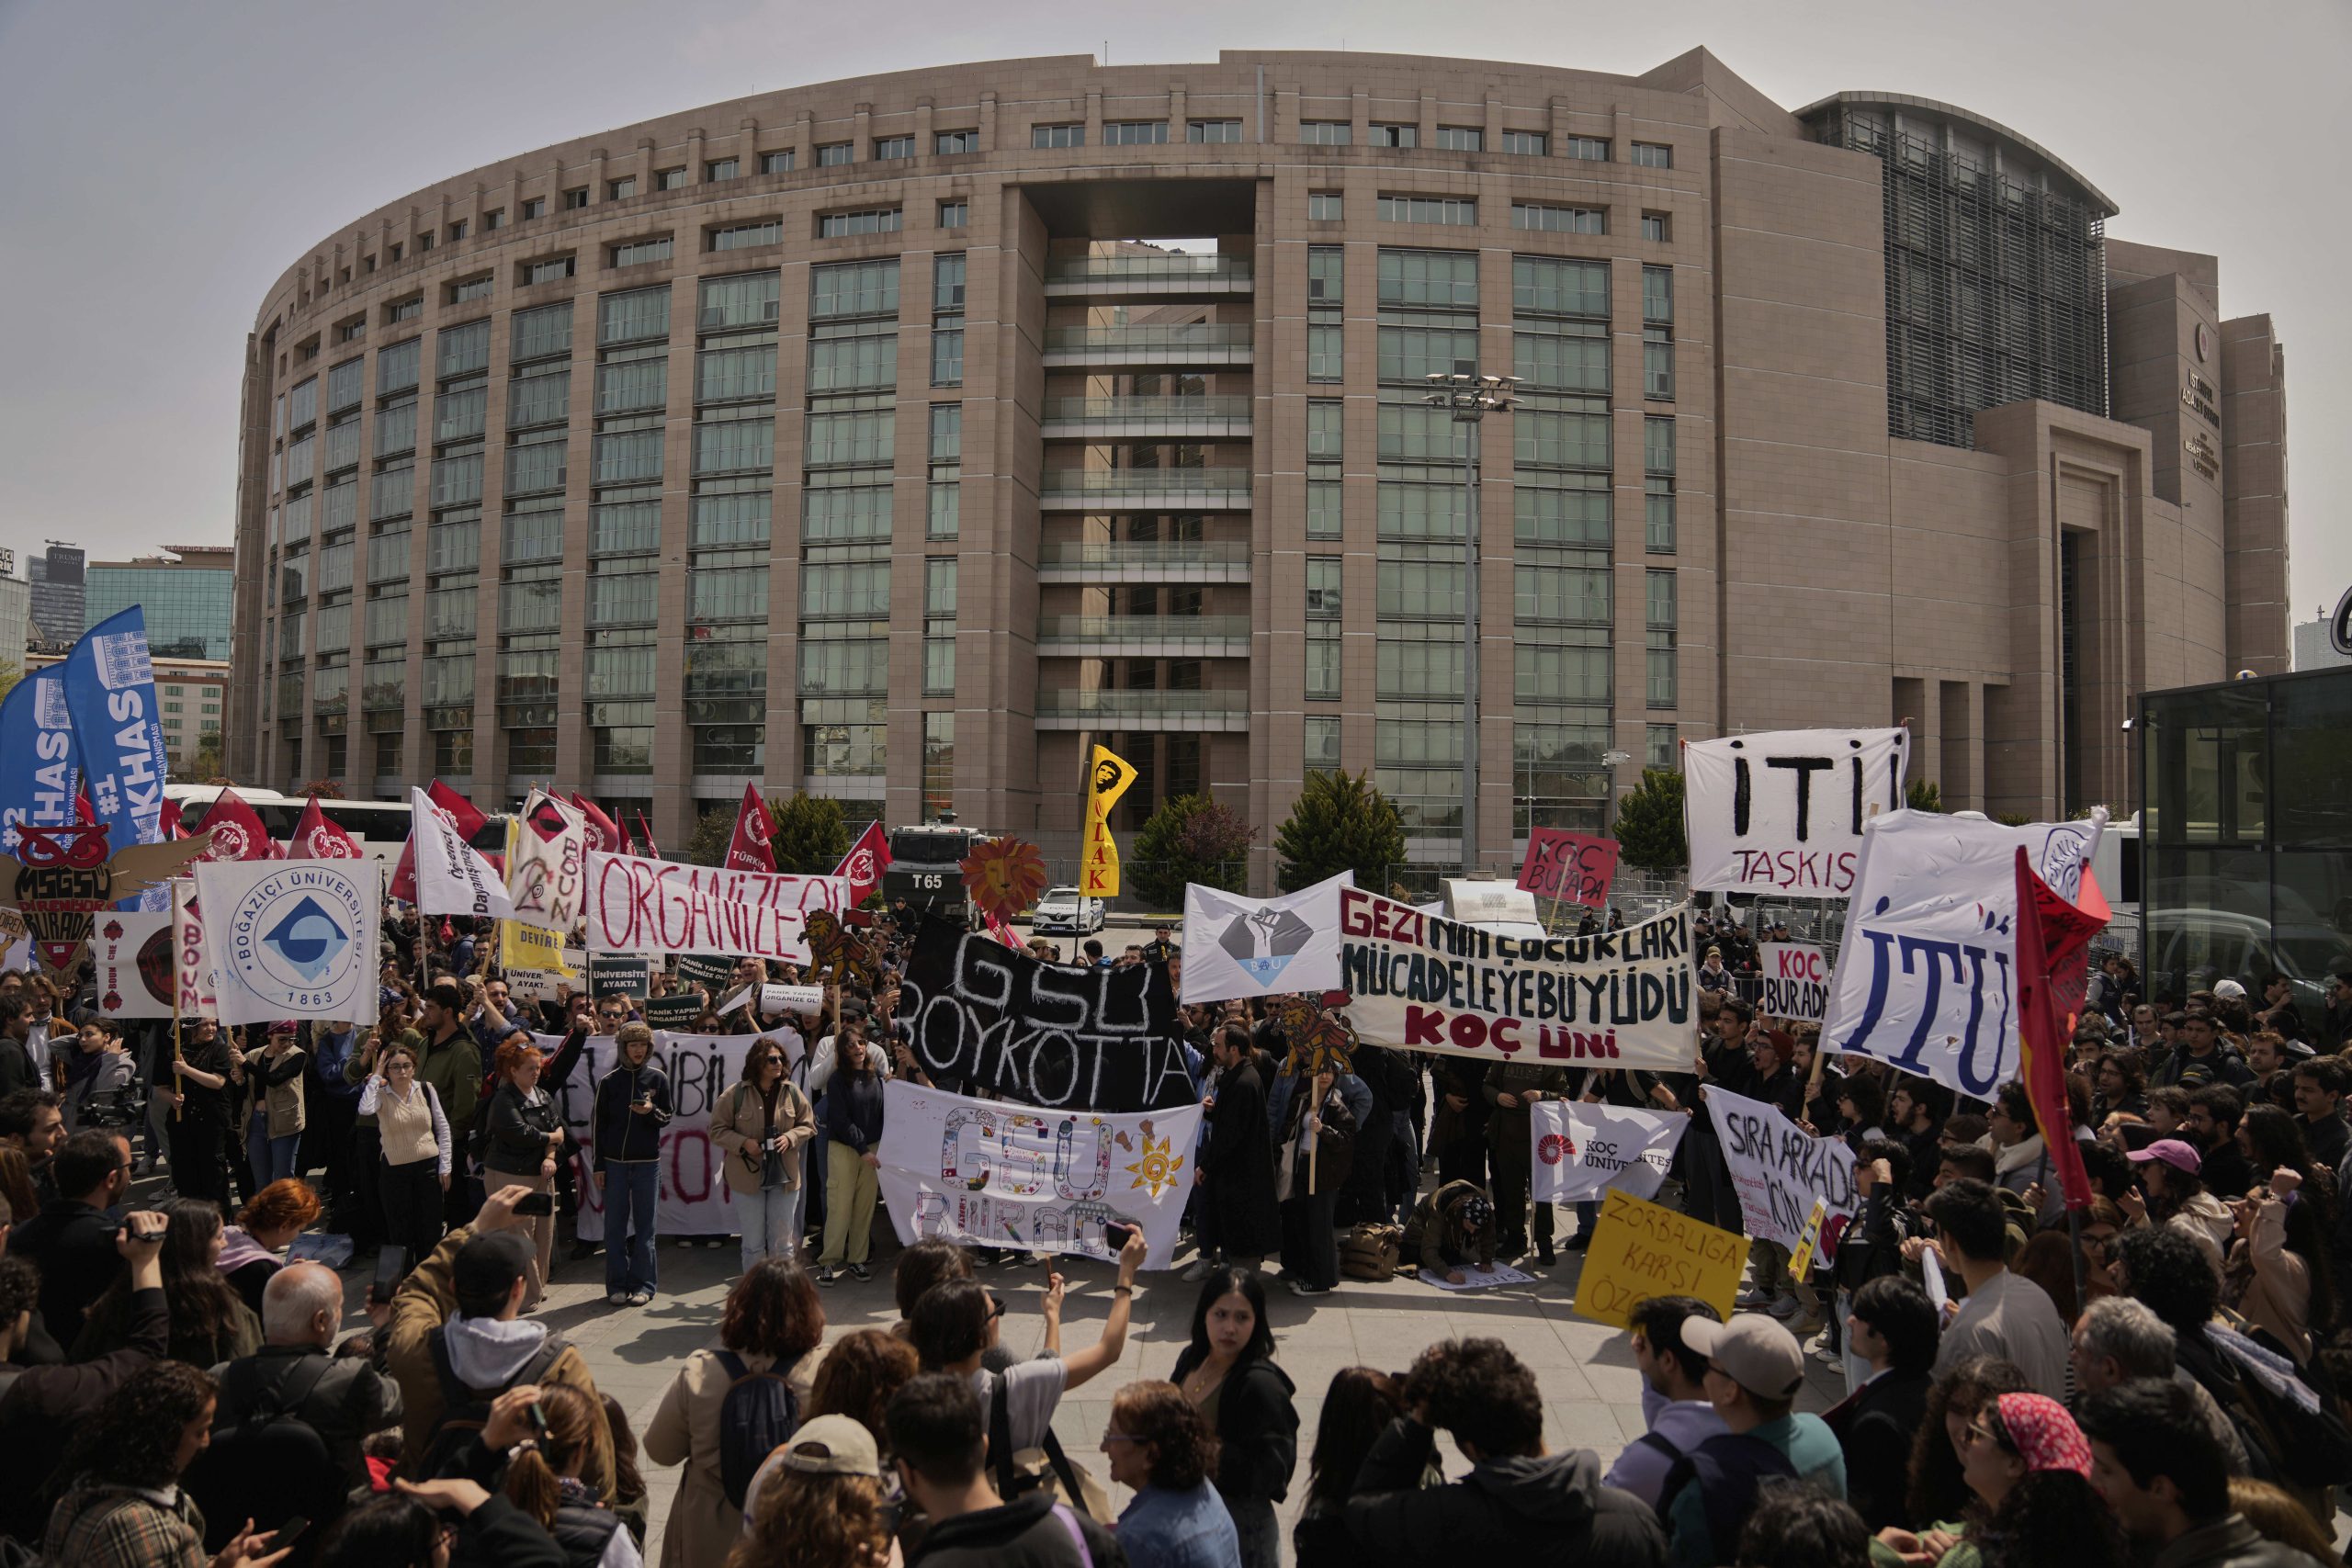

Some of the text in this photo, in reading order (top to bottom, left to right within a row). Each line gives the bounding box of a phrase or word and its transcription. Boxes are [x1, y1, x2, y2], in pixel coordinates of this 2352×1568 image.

[53, 552, 83, 562] TRUMP
[95, 773, 120, 816] #1
[220, 829, 241, 845] TİP
[1535, 838, 1603, 872] KOÇ
[912, 874, 943, 889] T 65
[1526, 864, 1604, 900] BURADA
[235, 876, 284, 960] BOĞAZİÇİ
[599, 857, 801, 959] ORGANİZE
[107, 944, 117, 989] BOUN CHE
[179, 923, 203, 1014] BOUN
[603, 980, 638, 988] AYAKTA
[680, 964, 714, 979] ORGANİZE
[682, 956, 729, 975] PANİK YAPMA
[1778, 950, 1823, 983] KOÇ
[287, 991, 334, 1006] 1863
[764, 995, 805, 1003] ORGANİZE
[1766, 977, 1830, 1020] BURADA
[1841, 896, 2010, 1096] İTÜ
[898, 979, 1197, 1112] BOYKOTTA
[1405, 1005, 1620, 1061] KOÇ ÜNİ
[1586, 1139, 1618, 1156] KOÇ
[1726, 1111, 1776, 1168] SIRA
[1607, 1195, 1738, 1269] ZORBALIĞA
[1622, 1241, 1702, 1292] KARŞI
